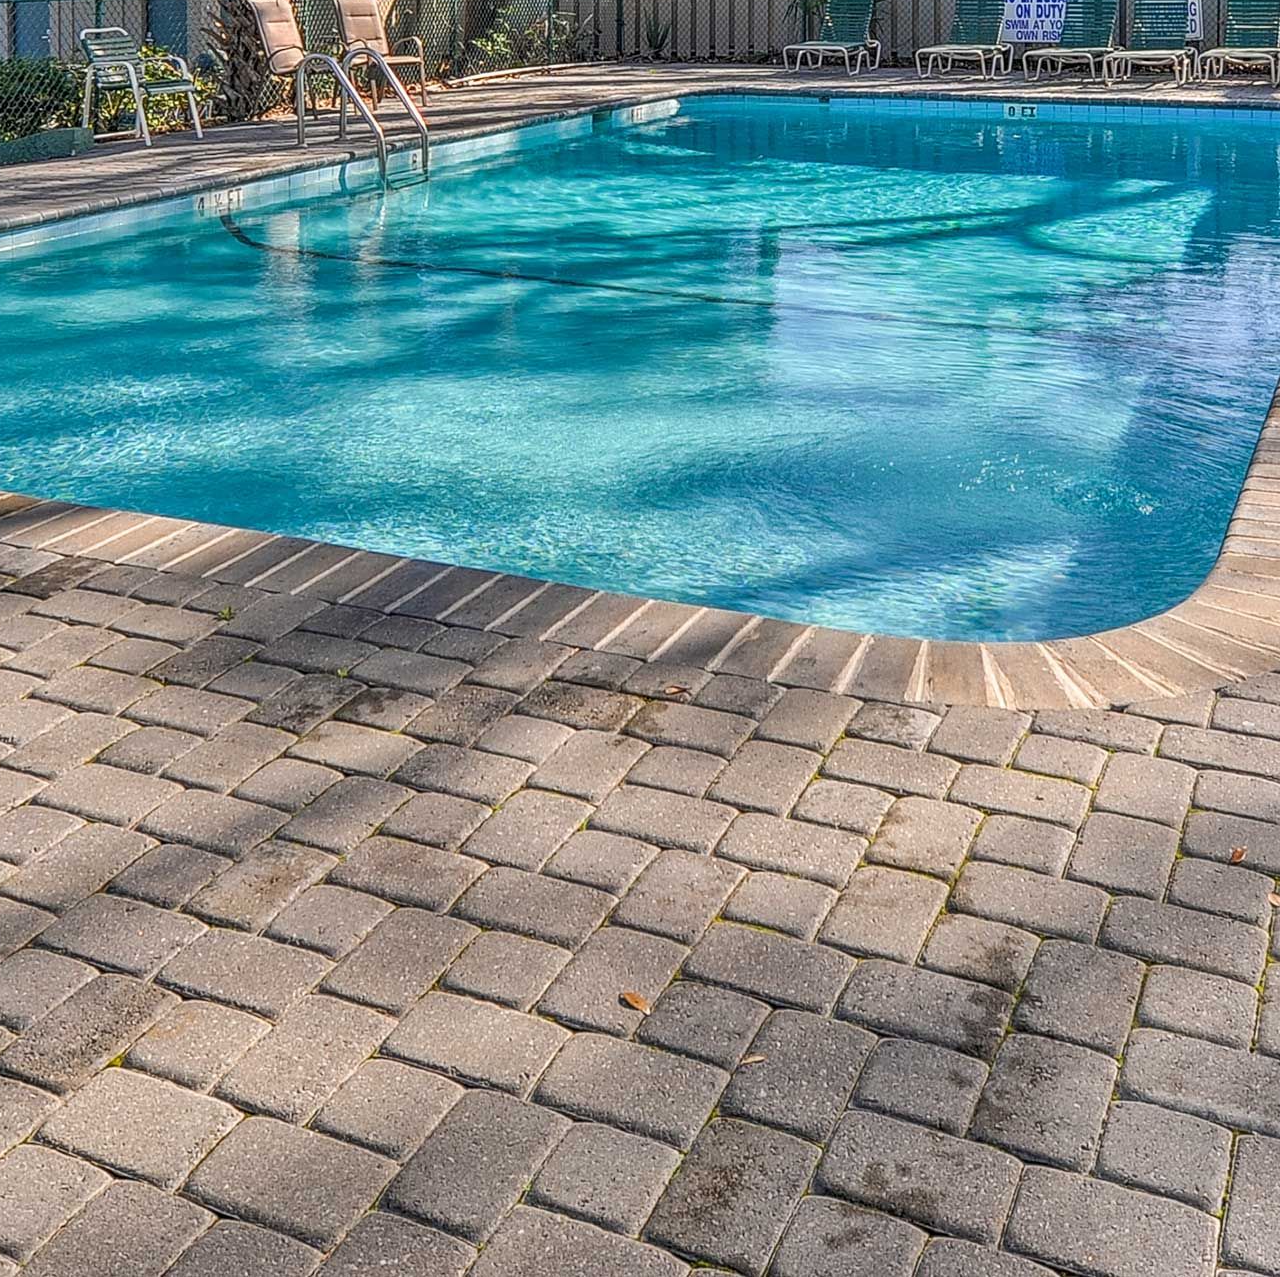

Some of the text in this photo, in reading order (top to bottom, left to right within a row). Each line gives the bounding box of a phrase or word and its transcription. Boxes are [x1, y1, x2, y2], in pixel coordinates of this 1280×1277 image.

[1016, 4, 1064, 18] ON DUTY
[1005, 20, 1063, 30] SWIM AT YO
[1016, 30, 1038, 41] OWN
